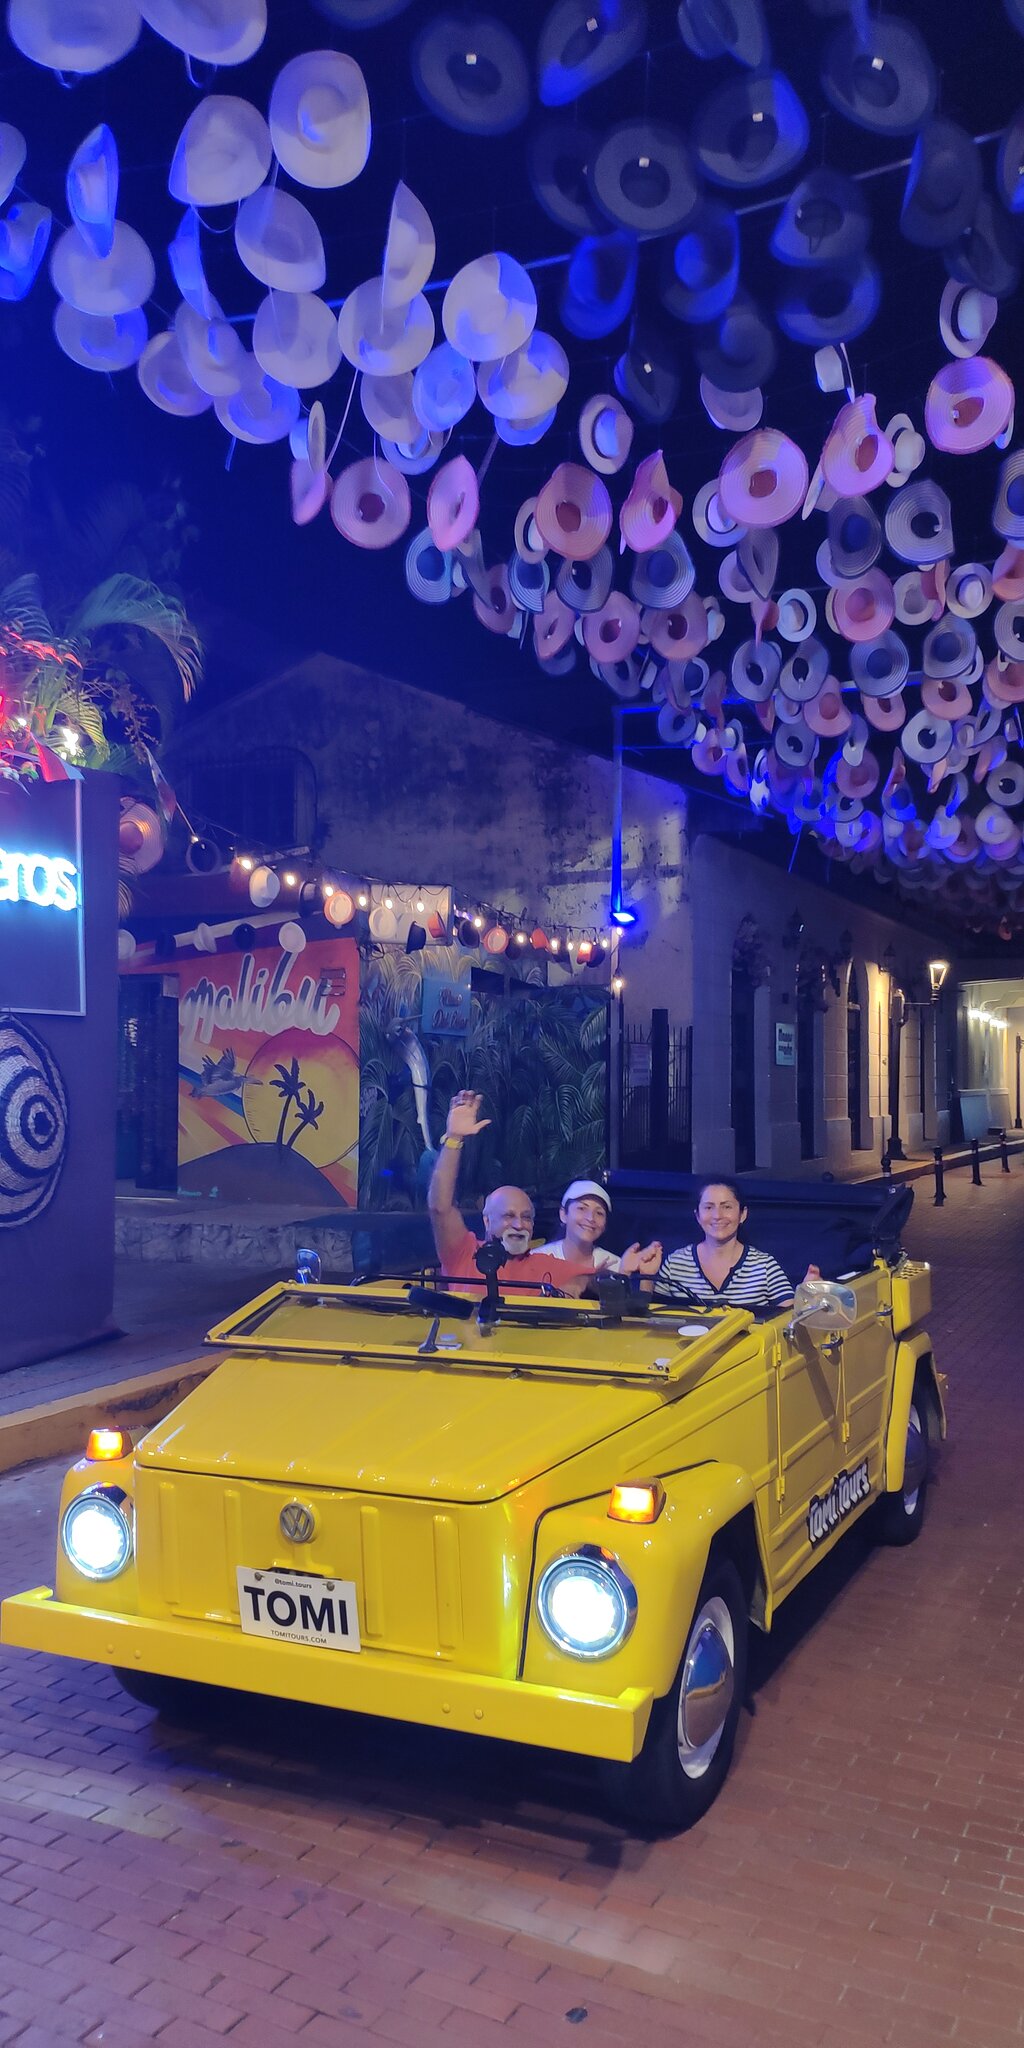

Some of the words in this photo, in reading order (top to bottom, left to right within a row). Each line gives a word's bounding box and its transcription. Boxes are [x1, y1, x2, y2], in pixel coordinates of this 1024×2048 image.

[279, 1503, 315, 1543] VW
[274, 1578, 312, 1589] @tomi.tours
[243, 1585, 349, 1636] TOMI
[271, 1629, 327, 1644] TOMITOURS.COM
